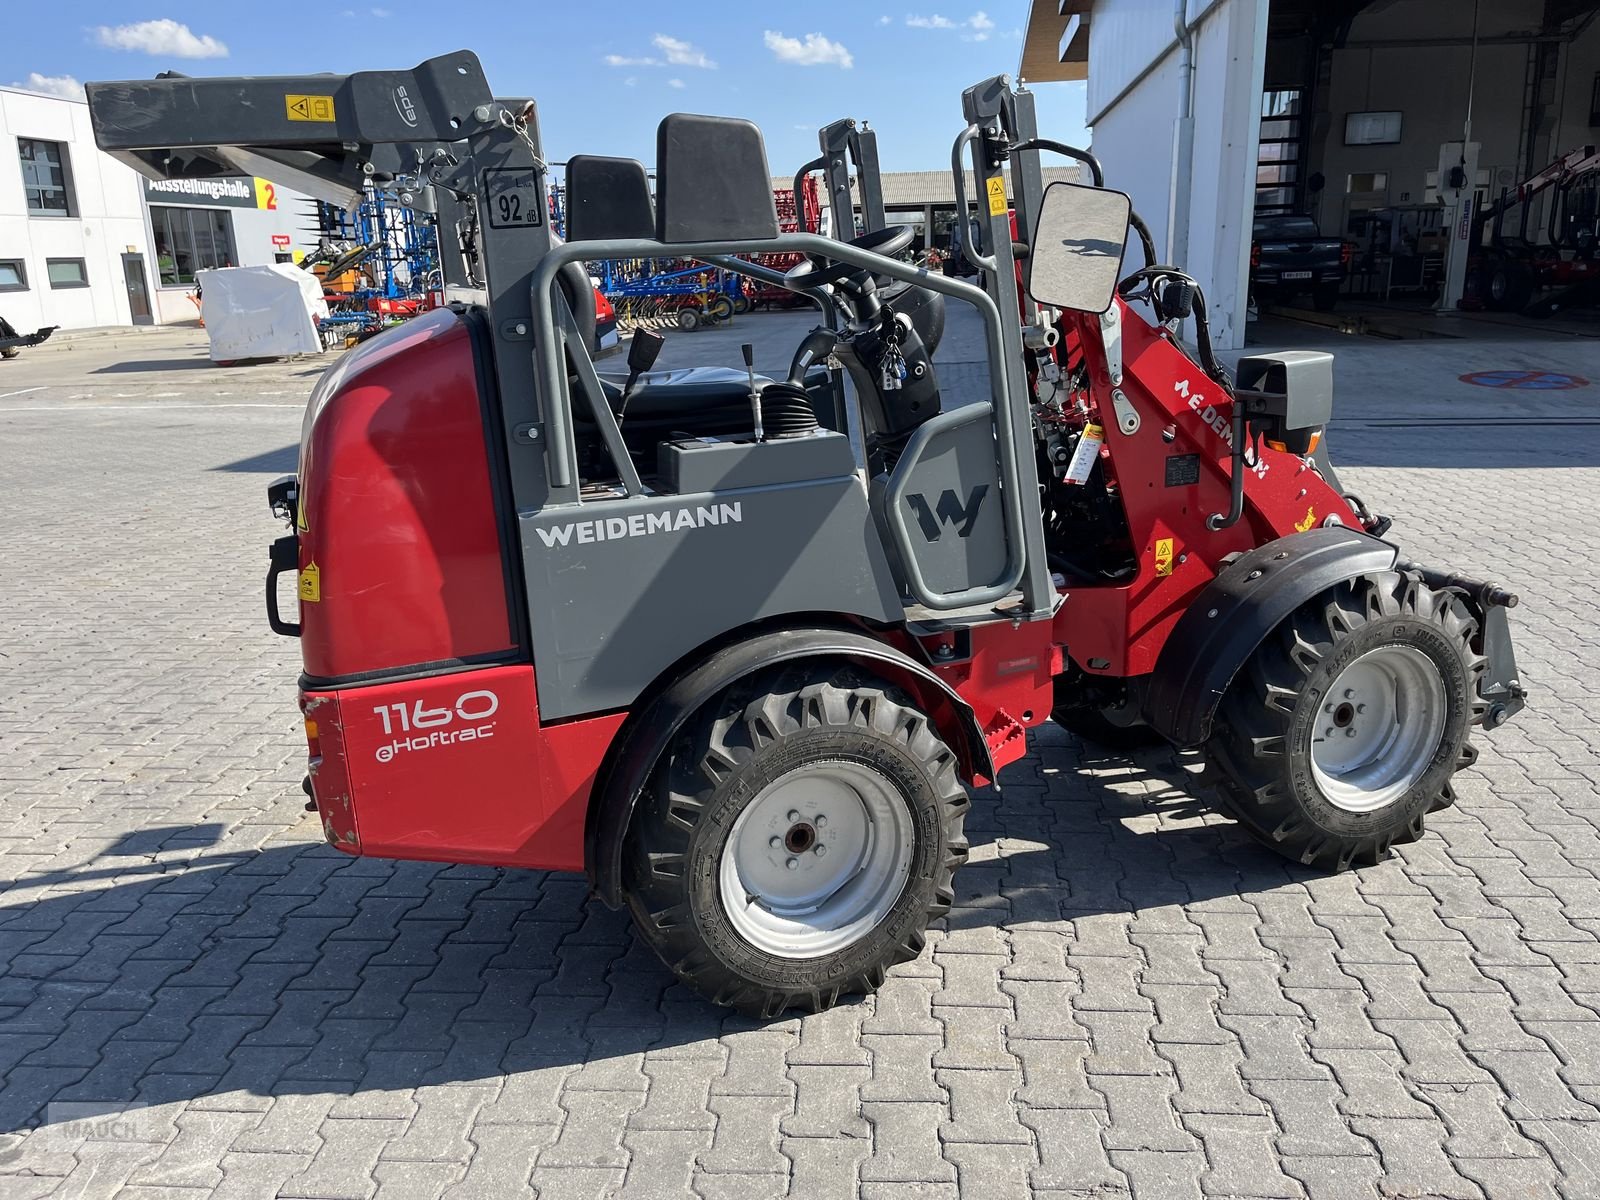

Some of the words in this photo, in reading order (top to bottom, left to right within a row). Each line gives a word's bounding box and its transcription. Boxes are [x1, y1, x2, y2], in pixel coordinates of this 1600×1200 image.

[396, 85, 418, 122] eps
[149, 177, 251, 200] Ausstellungshalle
[264, 183, 277, 210] 2
[499, 194, 523, 222] 92
[526, 209, 537, 223] dB
[535, 501, 743, 548] WEIDEMANN
[373, 690, 499, 735] 1160
[375, 724, 494, 763] eHoftrac
